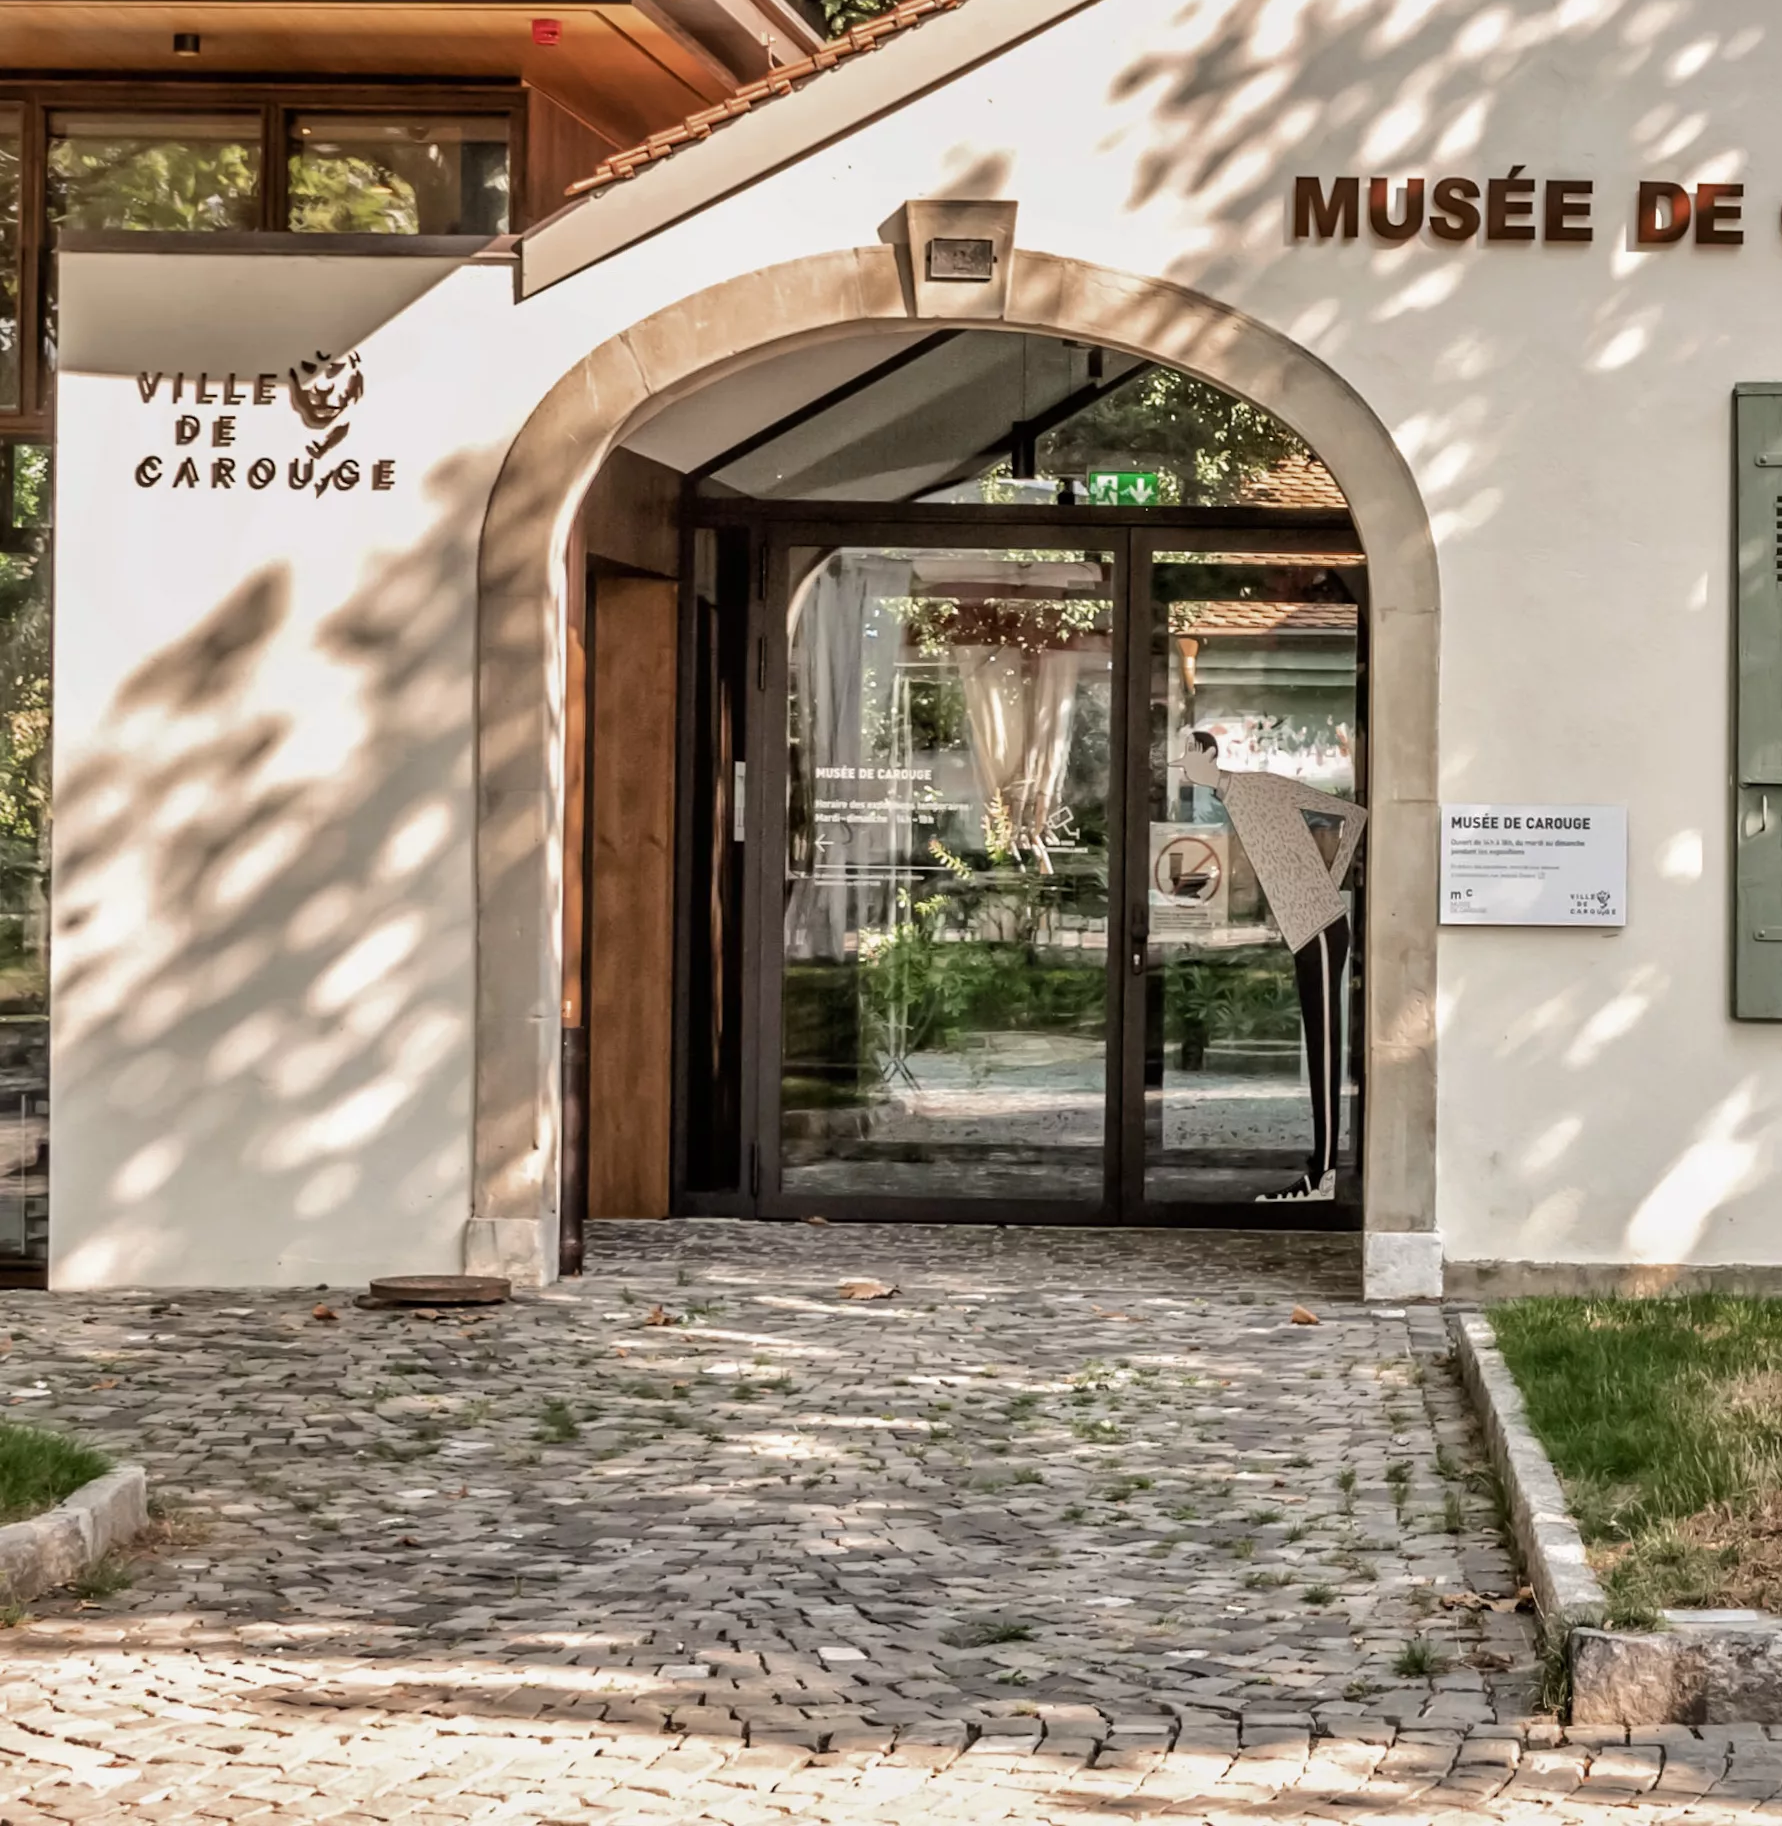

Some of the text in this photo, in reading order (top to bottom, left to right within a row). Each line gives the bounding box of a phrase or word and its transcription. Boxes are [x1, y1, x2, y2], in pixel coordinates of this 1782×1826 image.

[1292, 164, 1594, 242] MUSÉE
[1637, 181, 1746, 246] DE
[138, 372, 277, 404] VILLE
[177, 415, 236, 445] DE
[137, 455, 395, 489] CAROUGE
[815, 764, 933, 781] MUSÉE DE CAROUGE
[1451, 813, 1591, 830] MUSÉE DE CAROUGE
[1450, 839, 1472, 847] Ouvert
